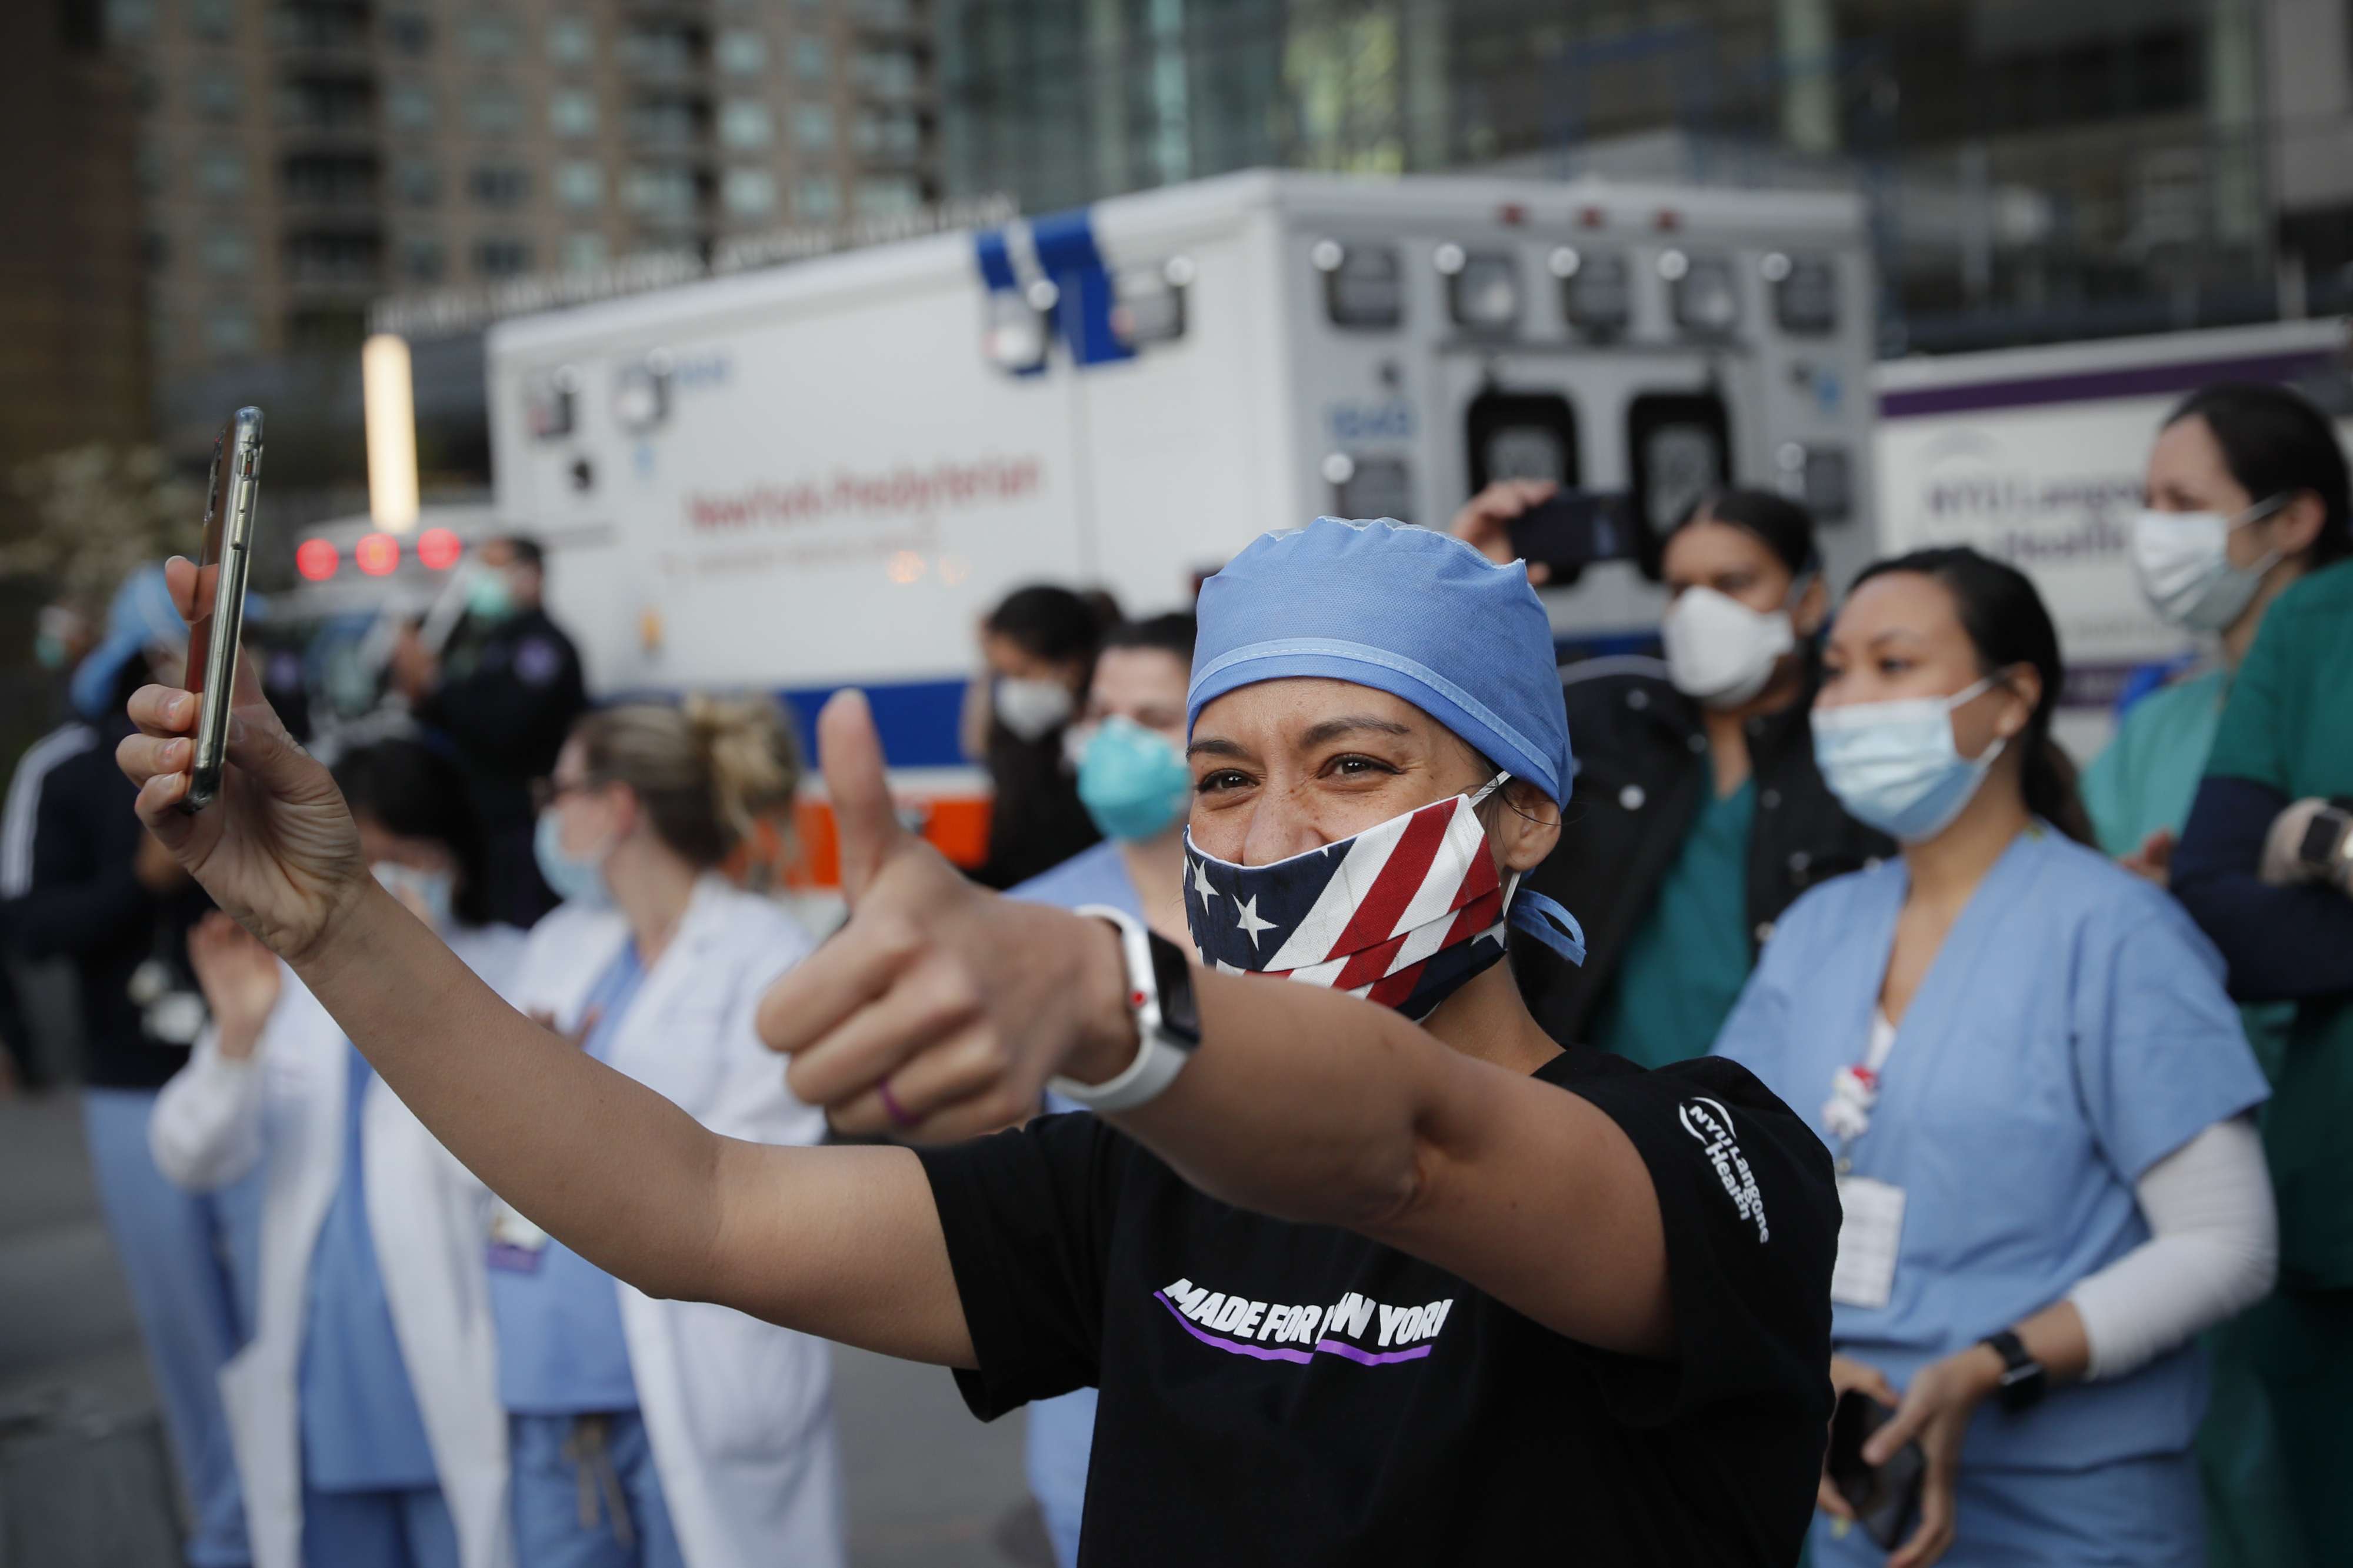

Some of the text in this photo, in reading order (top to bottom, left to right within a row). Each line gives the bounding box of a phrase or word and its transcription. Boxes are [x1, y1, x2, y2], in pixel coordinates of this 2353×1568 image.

[1689, 1105, 1769, 1244] NYU Langone
[1705, 1142, 1751, 1220] Health
[1162, 1278, 1268, 1337] MADE
[1257, 1305, 1322, 1345] FOR
